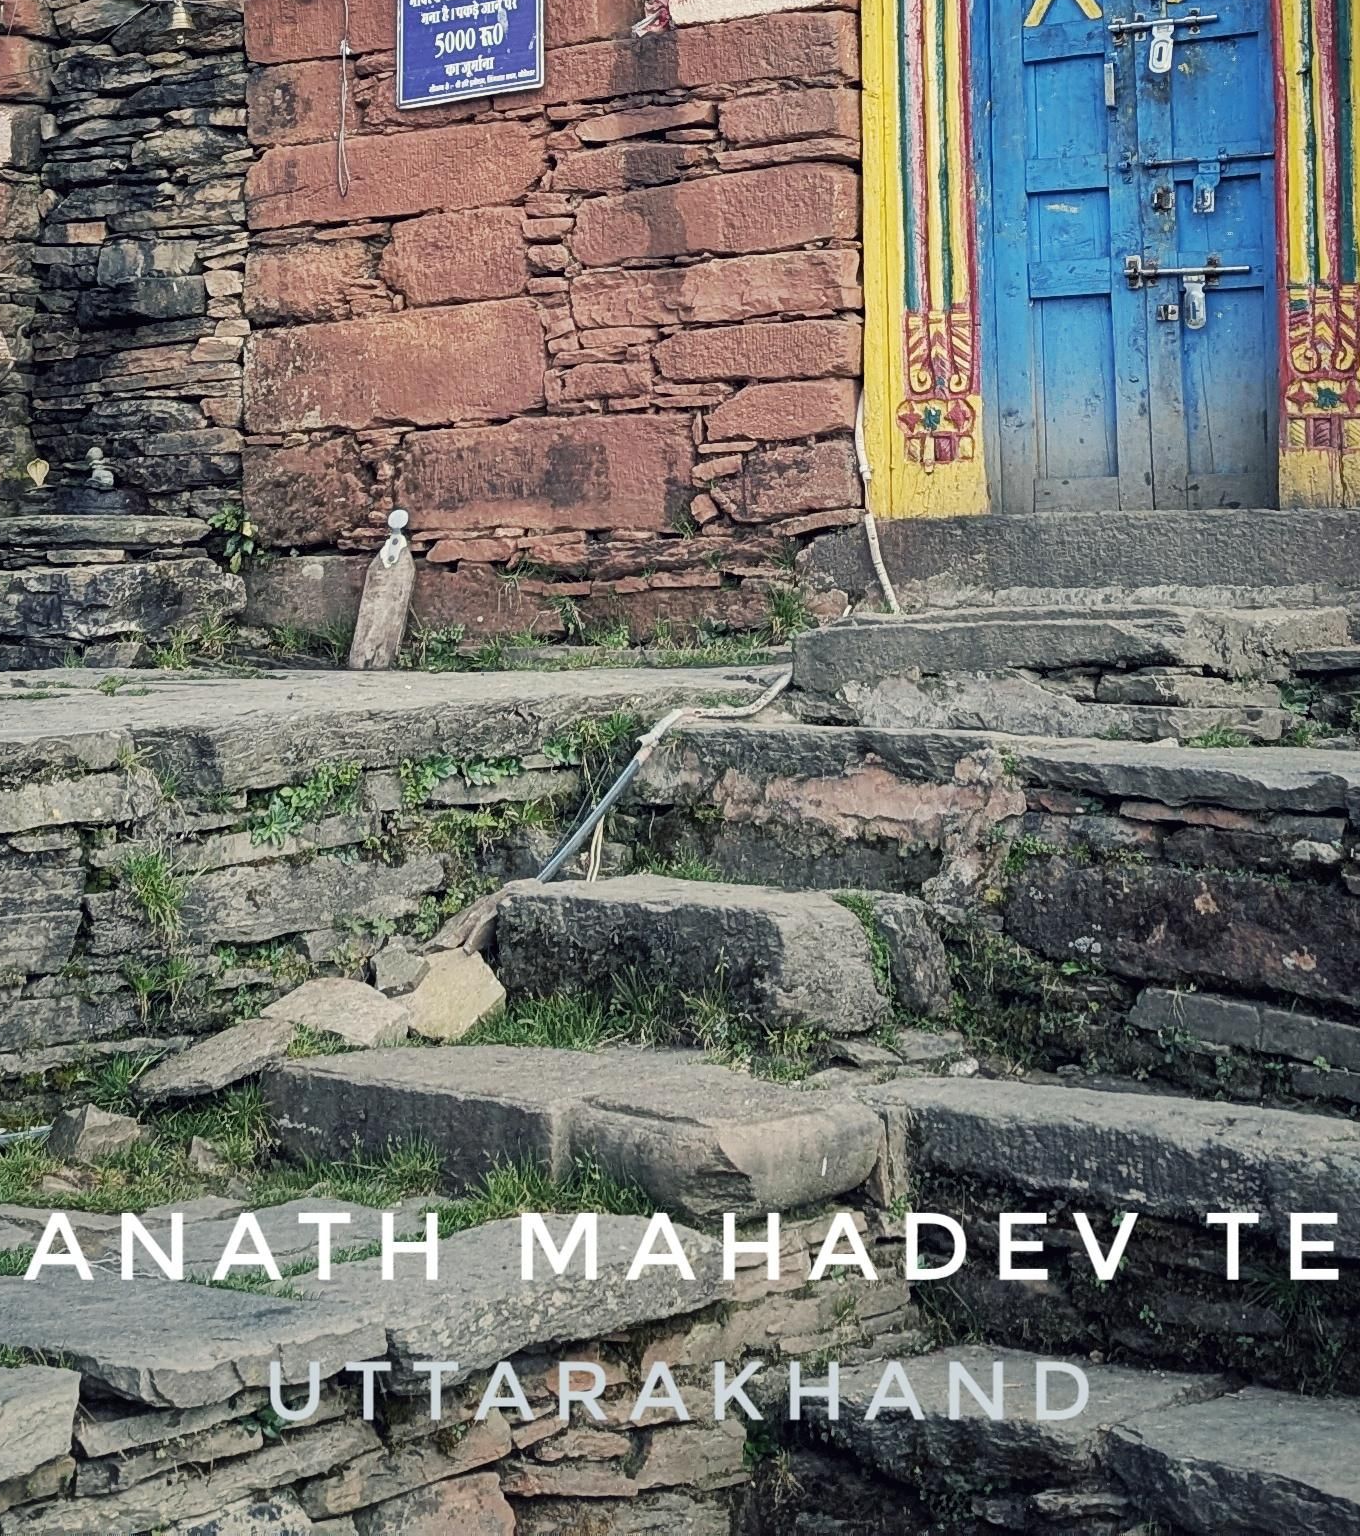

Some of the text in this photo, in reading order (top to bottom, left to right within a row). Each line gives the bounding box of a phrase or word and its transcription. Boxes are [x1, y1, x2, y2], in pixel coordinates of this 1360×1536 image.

[420, 10, 441, 25] मना
[434, 27, 476, 59] 5000
[444, 62, 460, 77] का
